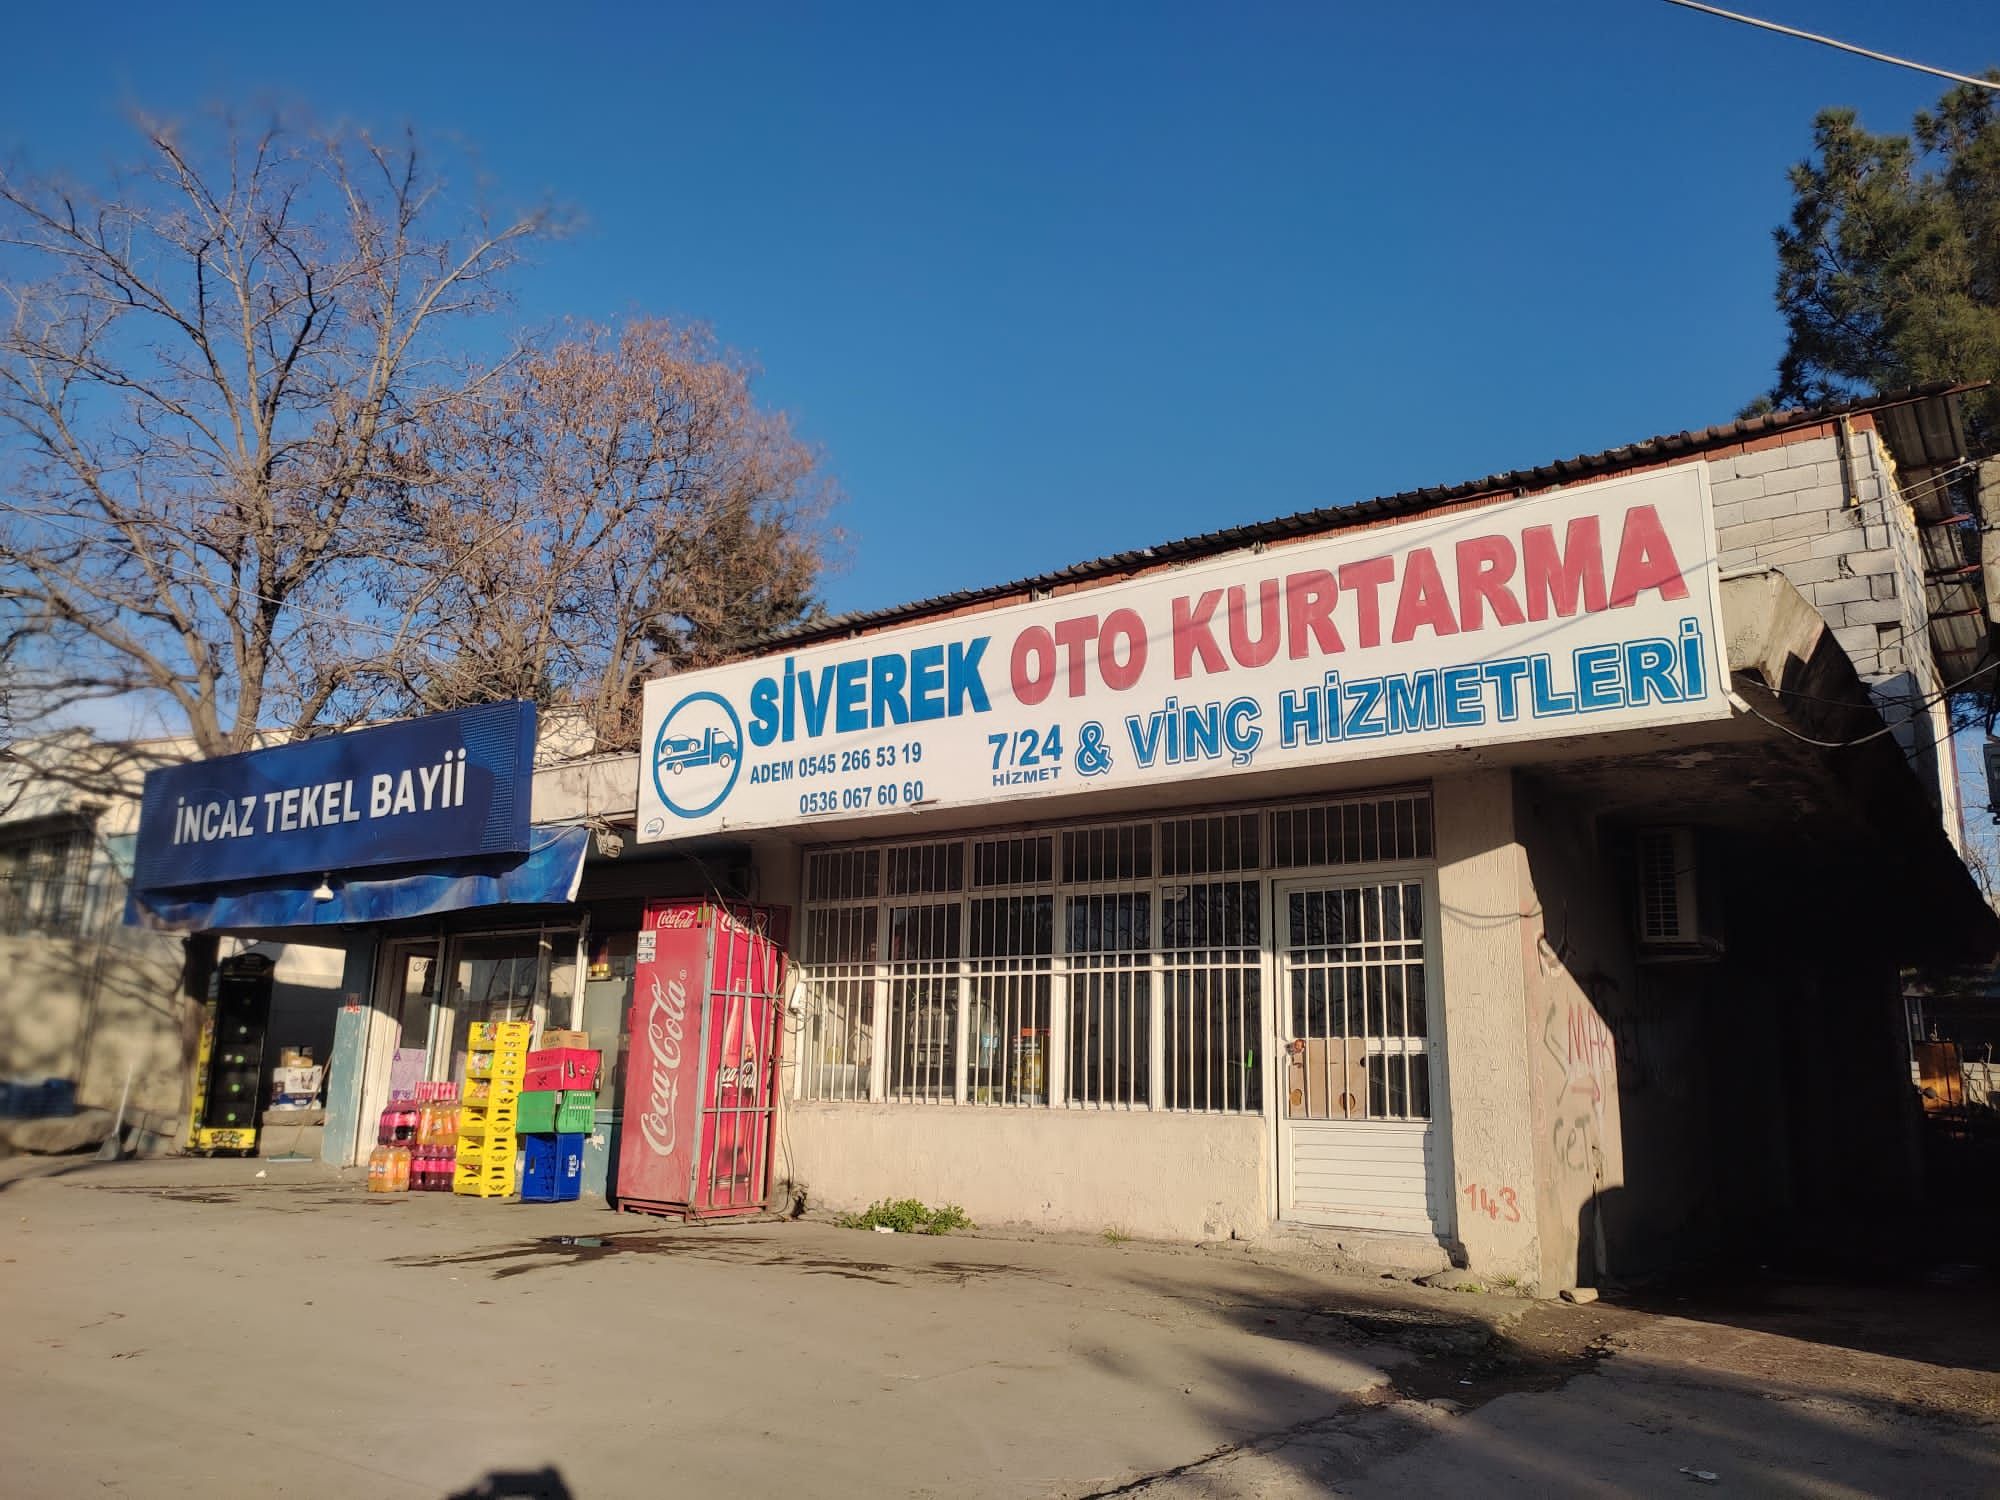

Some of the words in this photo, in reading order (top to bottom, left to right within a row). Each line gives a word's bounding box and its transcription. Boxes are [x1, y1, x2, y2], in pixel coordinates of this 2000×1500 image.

[747, 636, 992, 748] SİVEREK
[1010, 607, 1149, 706] OTO
[1171, 504, 1690, 681] KURTARMA
[988, 724, 1064, 771] 7/24
[1075, 720, 1114, 777] &
[1125, 695, 1263, 767] VİNÇ
[1279, 616, 1708, 749] HİZMETLERİ
[173, 795, 257, 845] İNCAZ
[262, 780, 361, 835] TEKEL
[369, 747, 467, 818] BAYİİ
[749, 759, 795, 785] ADEM
[798, 752, 837, 779] 0545
[841, 748, 871, 773] 266
[876, 744, 896, 768] 53
[902, 741, 923, 765] 19
[799, 790, 838, 815] 0536
[843, 786, 873, 810] 067
[877, 783, 898, 806] 60
[903, 780, 924, 804] 60
[991, 765, 1063, 787] HİZMET
[640, 971, 687, 1156] Coca-Cola
[1464, 1183, 1521, 1222] 143
